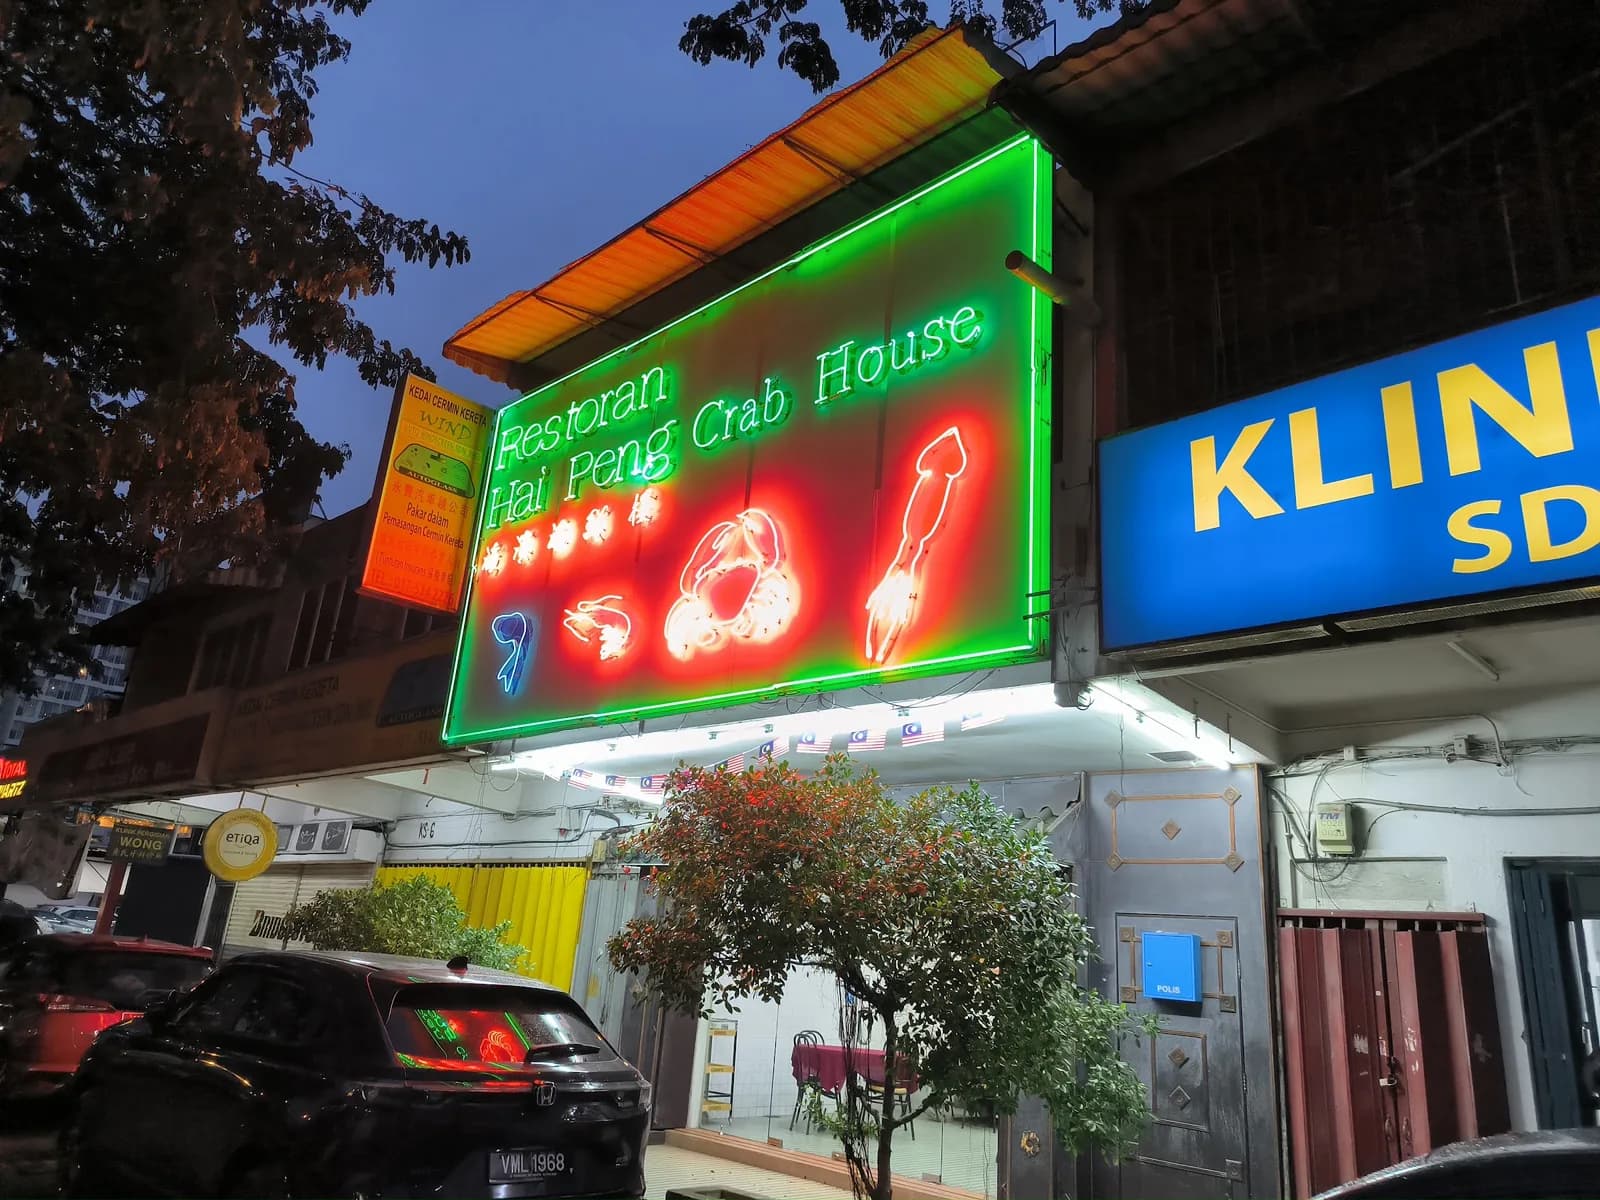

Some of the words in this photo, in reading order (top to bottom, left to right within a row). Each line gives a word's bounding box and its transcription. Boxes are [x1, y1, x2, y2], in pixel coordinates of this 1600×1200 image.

[409, 384, 432, 403] KEDAI
[432, 395, 460, 416] CERMIN
[460, 407, 487, 427] KERETA
[486, 466, 547, 528] Hai
[564, 420, 677, 501] Peng
[692, 378, 784, 448] Crab
[814, 306, 981, 405] House
[420, 410, 472, 440] WIND
[496, 367, 667, 471] Restoran
[408, 471, 458, 493] AUTOGLASS
[407, 502, 427, 521] Pakar
[427, 510, 449, 528] dalam
[120, 836, 162, 850] WONG
[1157, 984, 1180, 993] POLIS
[501, 1154, 529, 1174] VML
[532, 1153, 565, 1173] 1968
